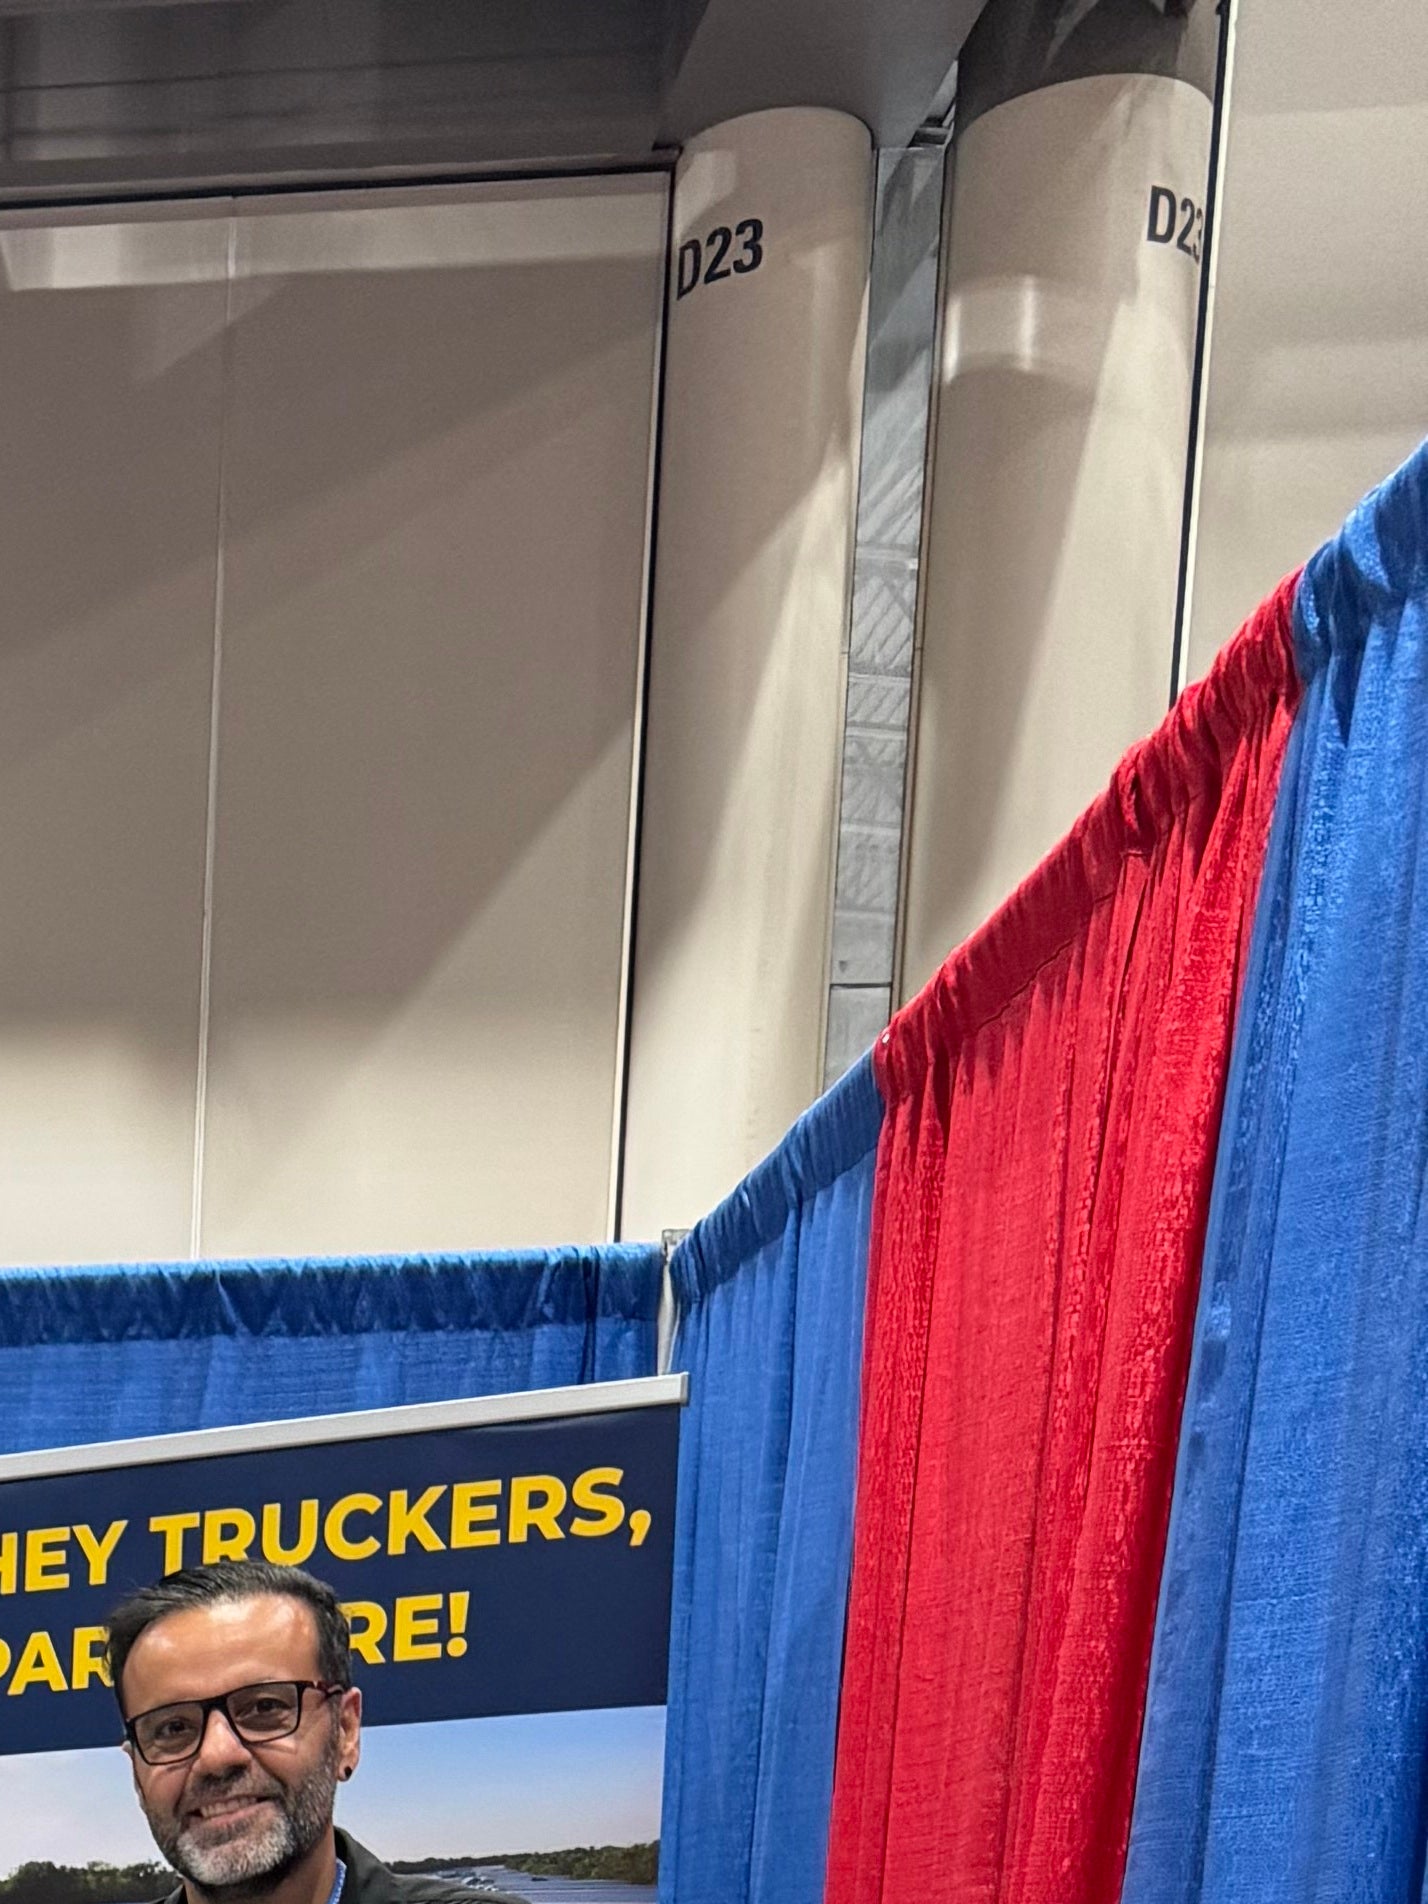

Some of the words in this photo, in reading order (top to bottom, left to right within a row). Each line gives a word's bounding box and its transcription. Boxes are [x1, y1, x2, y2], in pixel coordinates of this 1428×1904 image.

[677, 218, 763, 301] D23
[149, 1466, 652, 1576] TRUCKERS,
[341, 1591, 470, 1664] RE!
